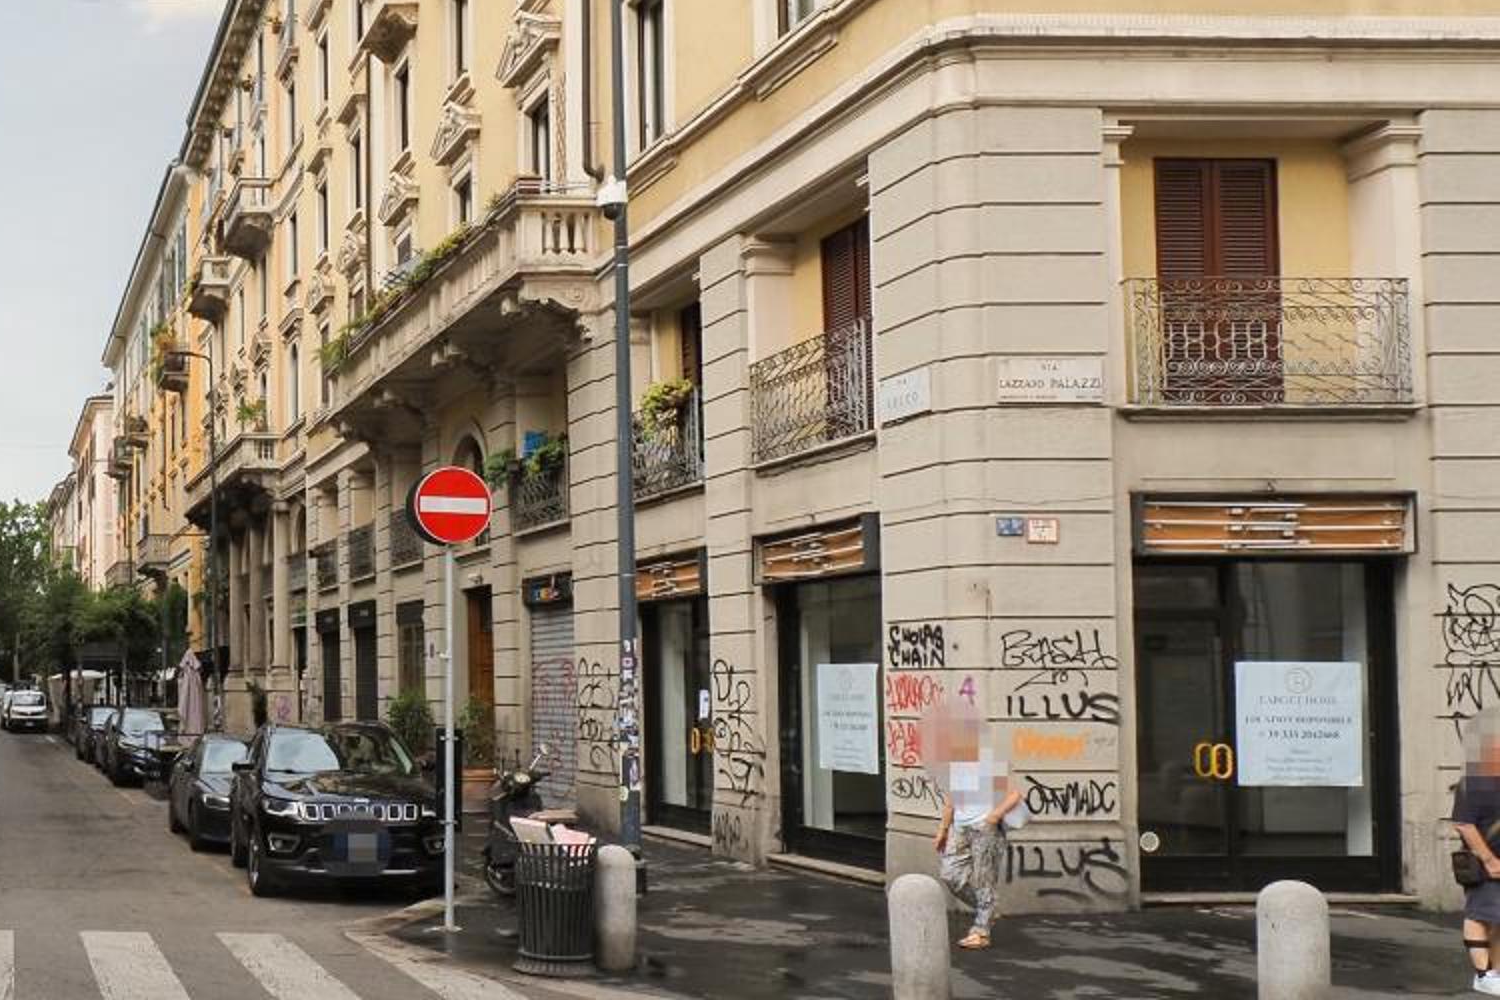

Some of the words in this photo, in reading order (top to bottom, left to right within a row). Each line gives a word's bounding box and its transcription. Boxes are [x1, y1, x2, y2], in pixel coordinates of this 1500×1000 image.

[999, 379, 1045, 389] LAZZARO
[1049, 376, 1103, 389] PALAZZI
[1007, 690, 1123, 726] ILLUS
